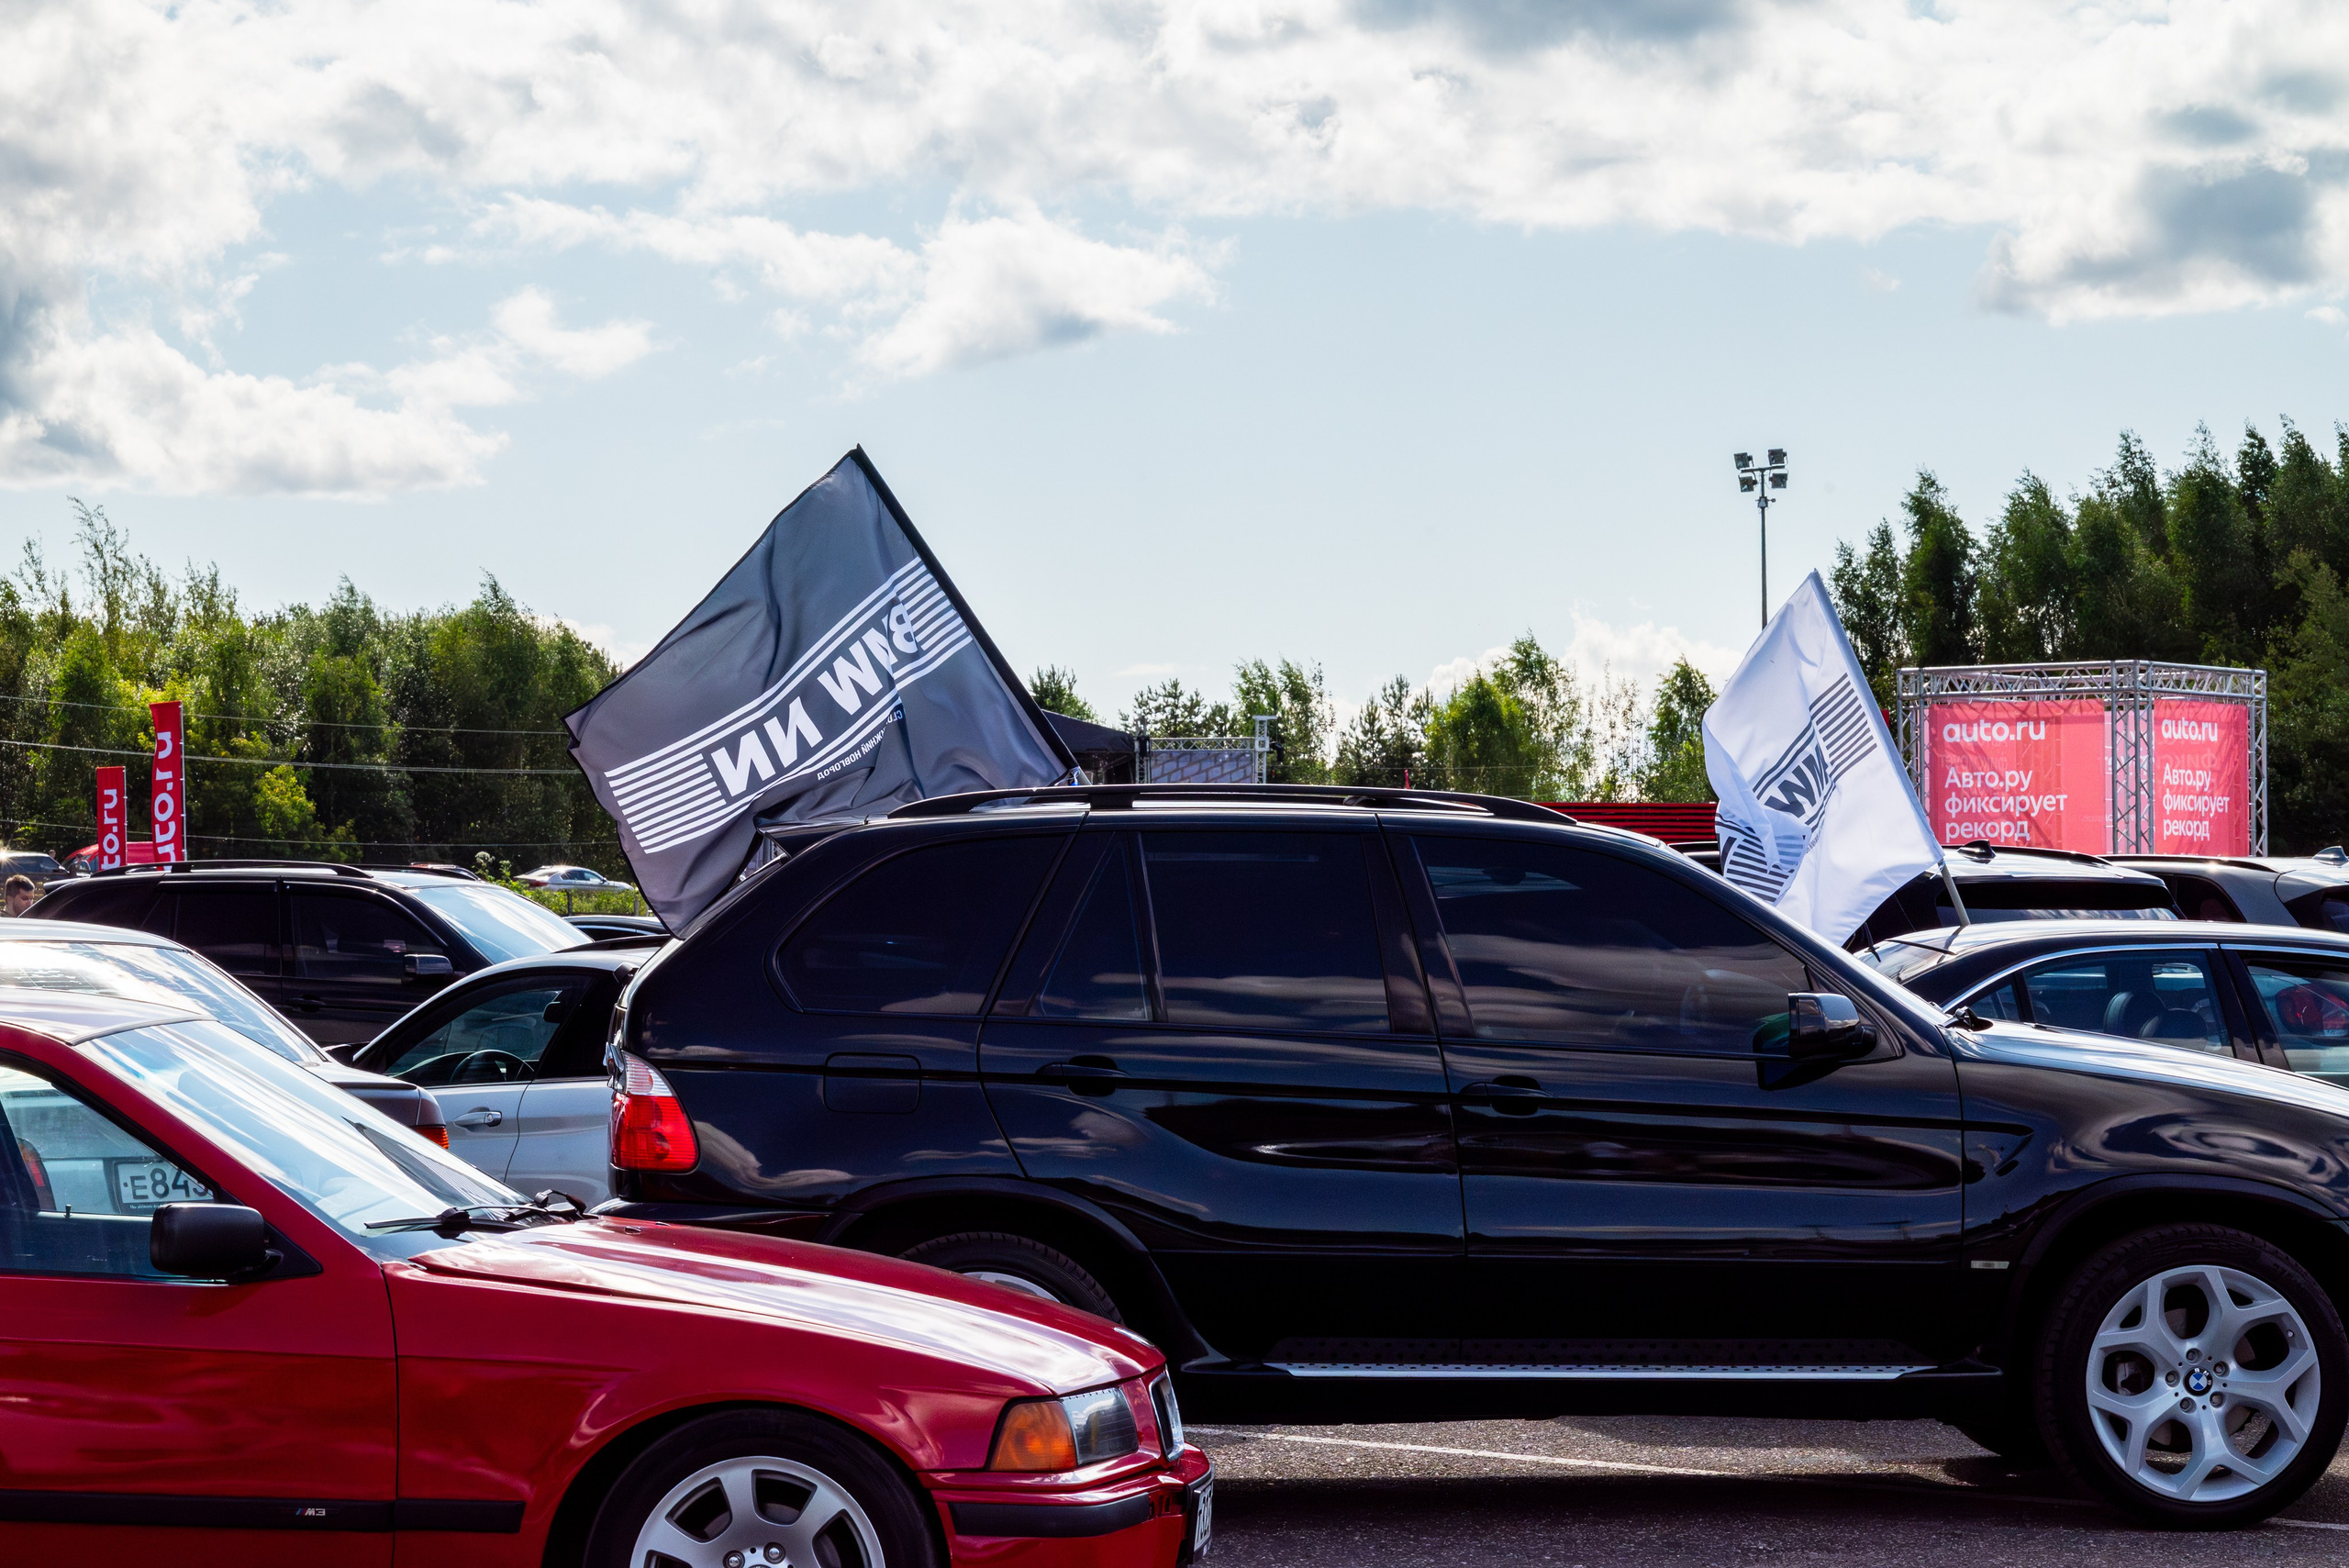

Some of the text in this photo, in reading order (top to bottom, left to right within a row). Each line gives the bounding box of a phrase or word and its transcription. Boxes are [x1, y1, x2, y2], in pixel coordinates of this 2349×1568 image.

[1943, 719, 2045, 742] auto.ru
[2161, 717, 2218, 741] auto.ru
[1944, 767, 2033, 792] Авто.ру
[2162, 763, 2211, 792] Авто.ру
[1944, 792, 2068, 818] фиксирует
[2162, 788, 2230, 817] фиксирует
[1945, 820, 2031, 843] рекорд
[2163, 818, 2210, 841] рекорд
[2194, 1367, 2212, 1385] BMW
